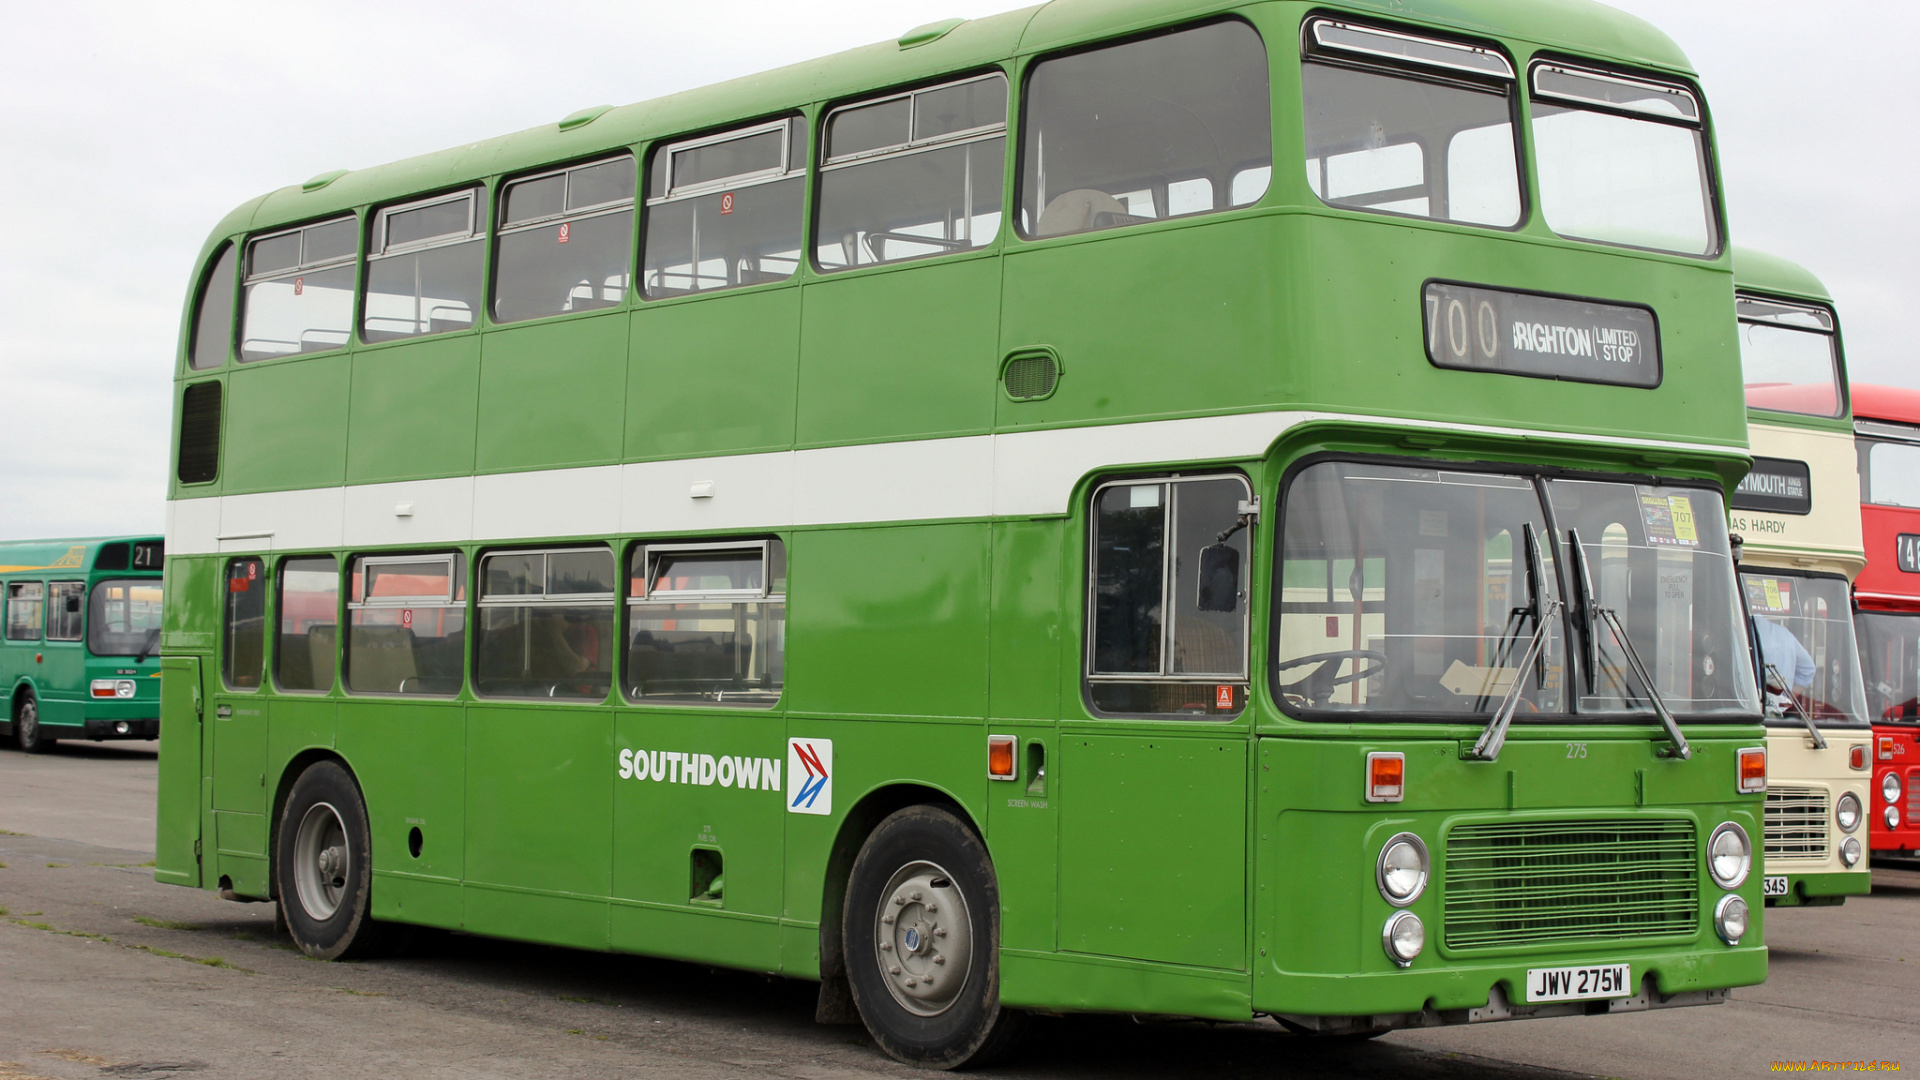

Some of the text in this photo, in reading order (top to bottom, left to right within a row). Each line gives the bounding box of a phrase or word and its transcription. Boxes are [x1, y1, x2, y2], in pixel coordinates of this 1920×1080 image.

[1426, 294, 1498, 358] 700
[1787, 477, 1802, 487] KINGS
[1787, 486, 1804, 497] STATUE
[1673, 511, 1691, 523] 707
[1729, 517, 1786, 534] AS HARDY
[134, 546, 152, 566] 21
[1660, 575, 1688, 584] EMERGENCY
[1668, 583, 1680, 591] PULL
[1671, 590, 1685, 599] OPEN
[1220, 689, 1229, 700] A
[1565, 742, 1588, 759] 275
[1893, 743, 1905, 755] 526
[618, 748, 781, 792] SOUTHDOWN
[1007, 798, 1049, 809] SCREEN WASH
[1764, 878, 1786, 893] 34S
[1535, 967, 1623, 996] JWV 275W
